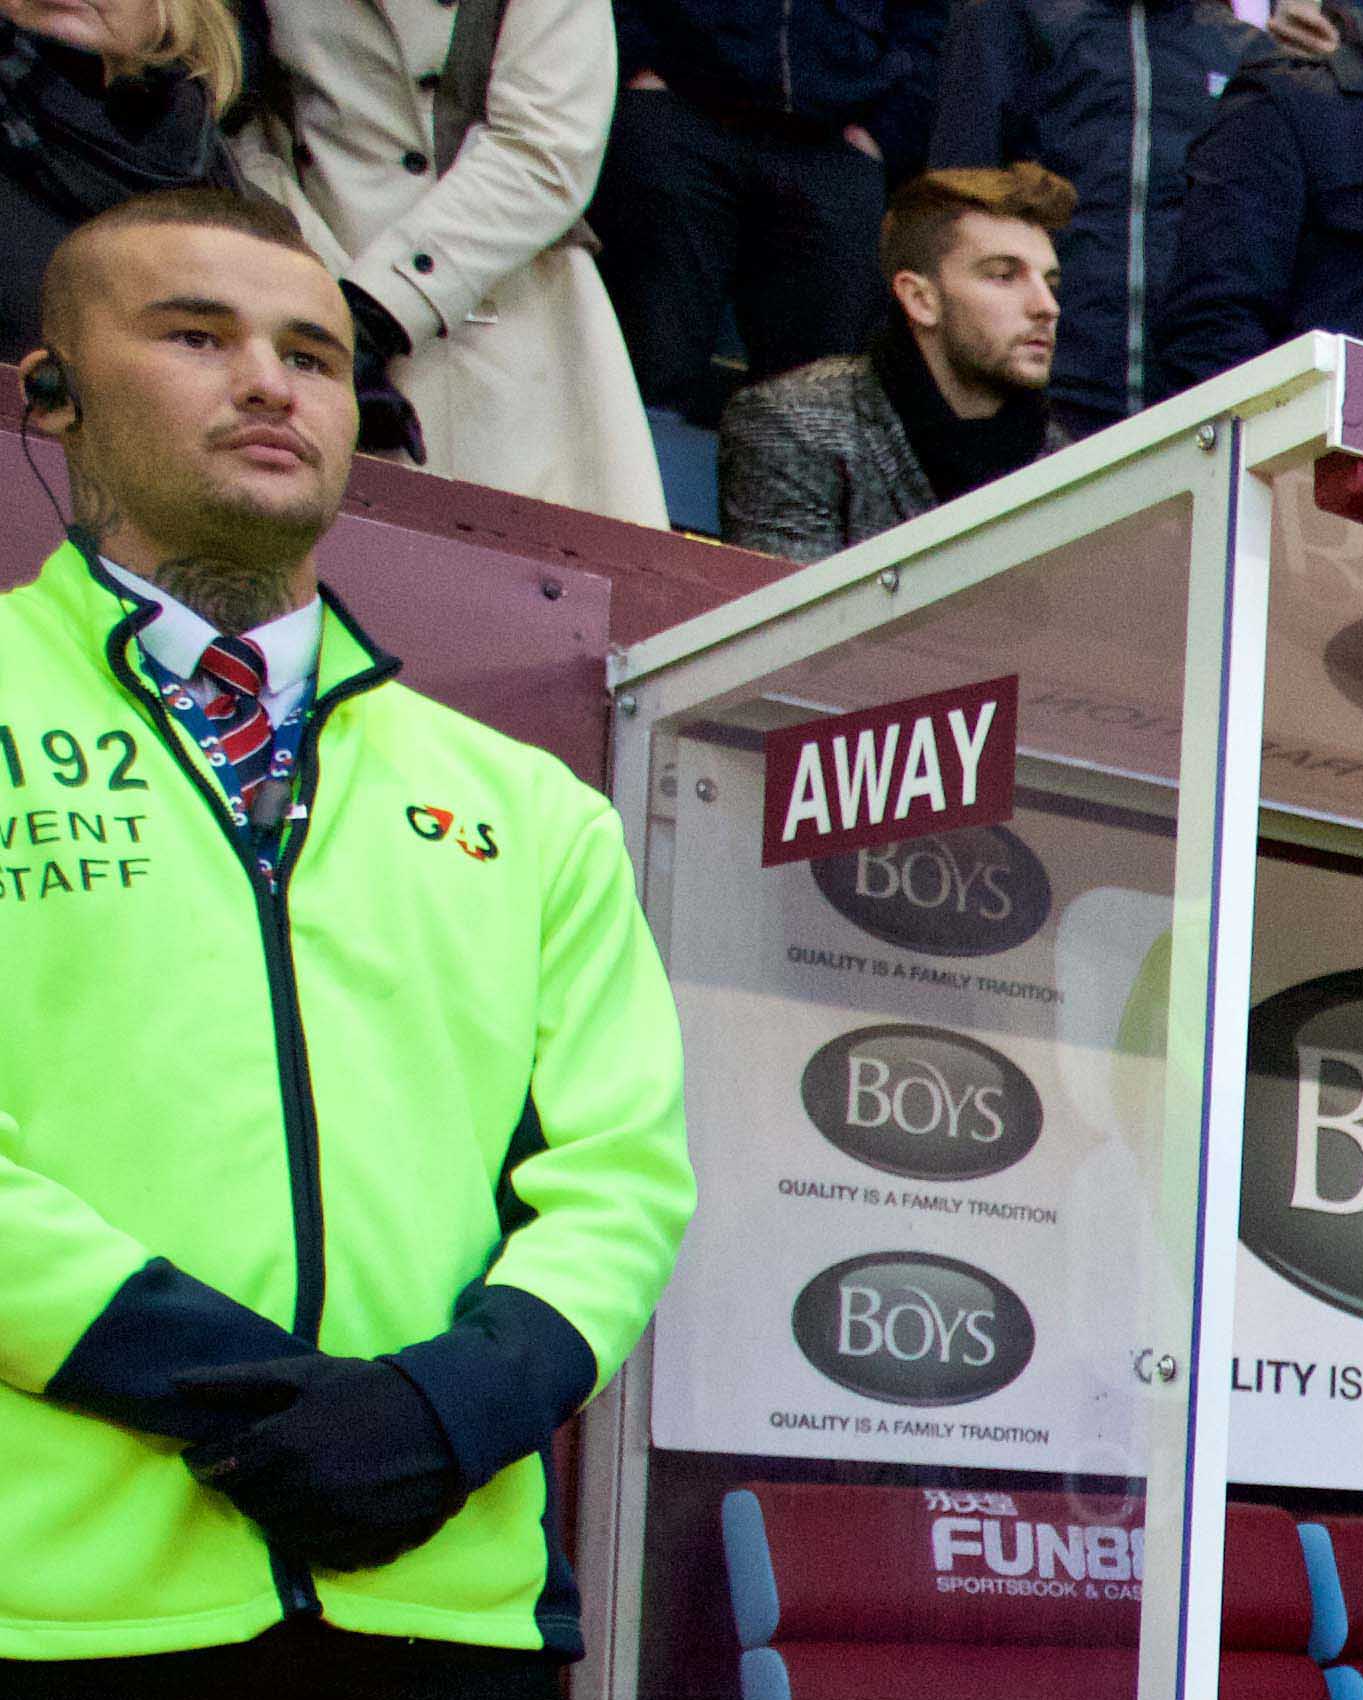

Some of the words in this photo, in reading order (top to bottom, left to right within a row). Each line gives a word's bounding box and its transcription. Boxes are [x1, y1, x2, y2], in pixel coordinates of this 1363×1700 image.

[781, 701, 997, 842] AWAY
[0, 810, 147, 849] VENT
[0, 858, 150, 901] TAFF
[856, 838, 1013, 920] BOYS
[786, 946, 868, 973] QUALITY
[872, 958, 888, 977] IS
[892, 963, 906, 977] A
[910, 965, 970, 989] FAMILY
[977, 976, 1065, 1004] TRADITION
[846, 1056, 1005, 1143] BOYS
[778, 1178, 858, 1202] QUALITY
[863, 1186, 880, 1204] IS
[885, 1189, 898, 1205] A
[901, 1191, 964, 1214] FAMILY
[968, 1200, 1058, 1225] TRADITION
[838, 1281, 996, 1366] BOYS
[1231, 1357, 1317, 1396] LITY
[1330, 1365, 1362, 1401] IS
[769, 1410, 850, 1433] QUALITY
[854, 1416, 872, 1434] IS
[877, 1418, 890, 1435] A
[893, 1419, 955, 1441] FAMILY
[960, 1423, 1050, 1446] TRADITION
[936, 1576, 1078, 1598] SPORTSBOOK
[1085, 1583, 1099, 1600] &
[1104, 1583, 1143, 1600] CAS
